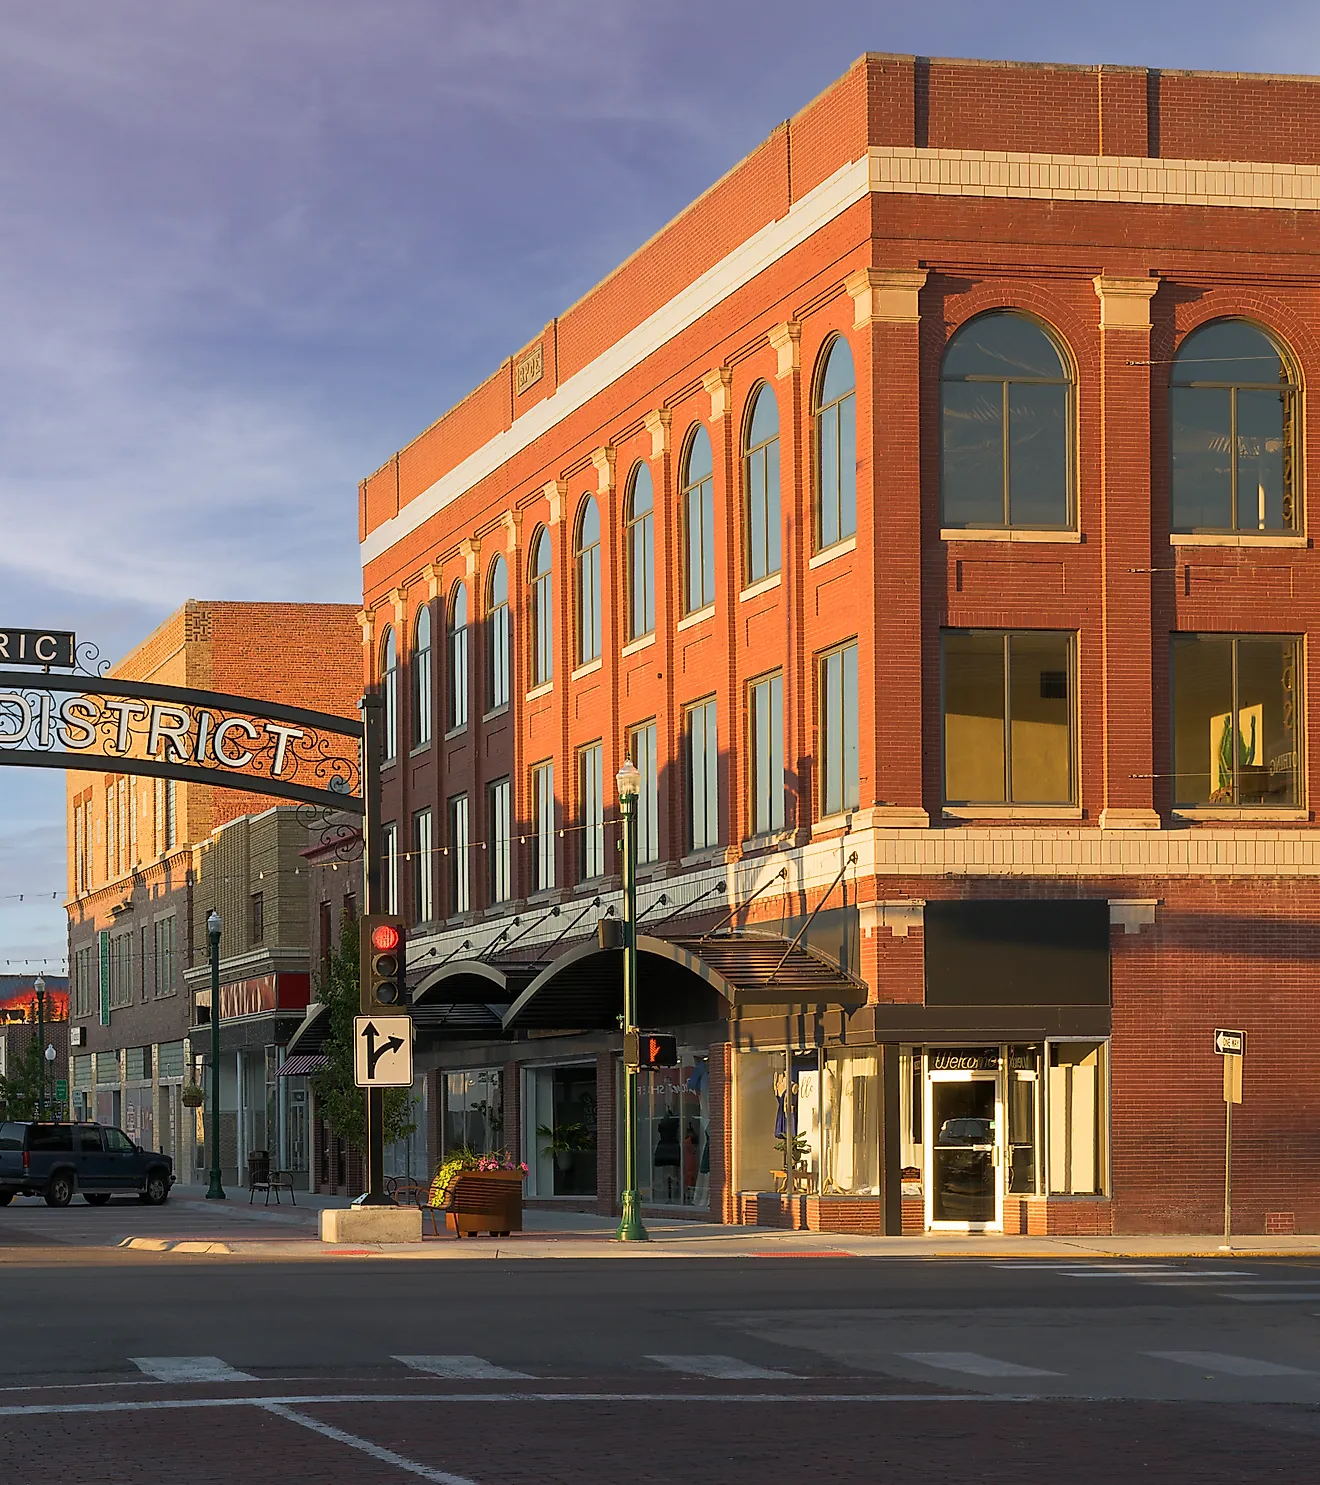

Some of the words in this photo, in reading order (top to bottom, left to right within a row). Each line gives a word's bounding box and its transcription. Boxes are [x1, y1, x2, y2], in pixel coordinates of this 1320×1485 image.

[1222, 1037, 1231, 1047] ONE
[1231, 1038, 1240, 1048] WAY
[934, 1052, 997, 1069] Welcome
